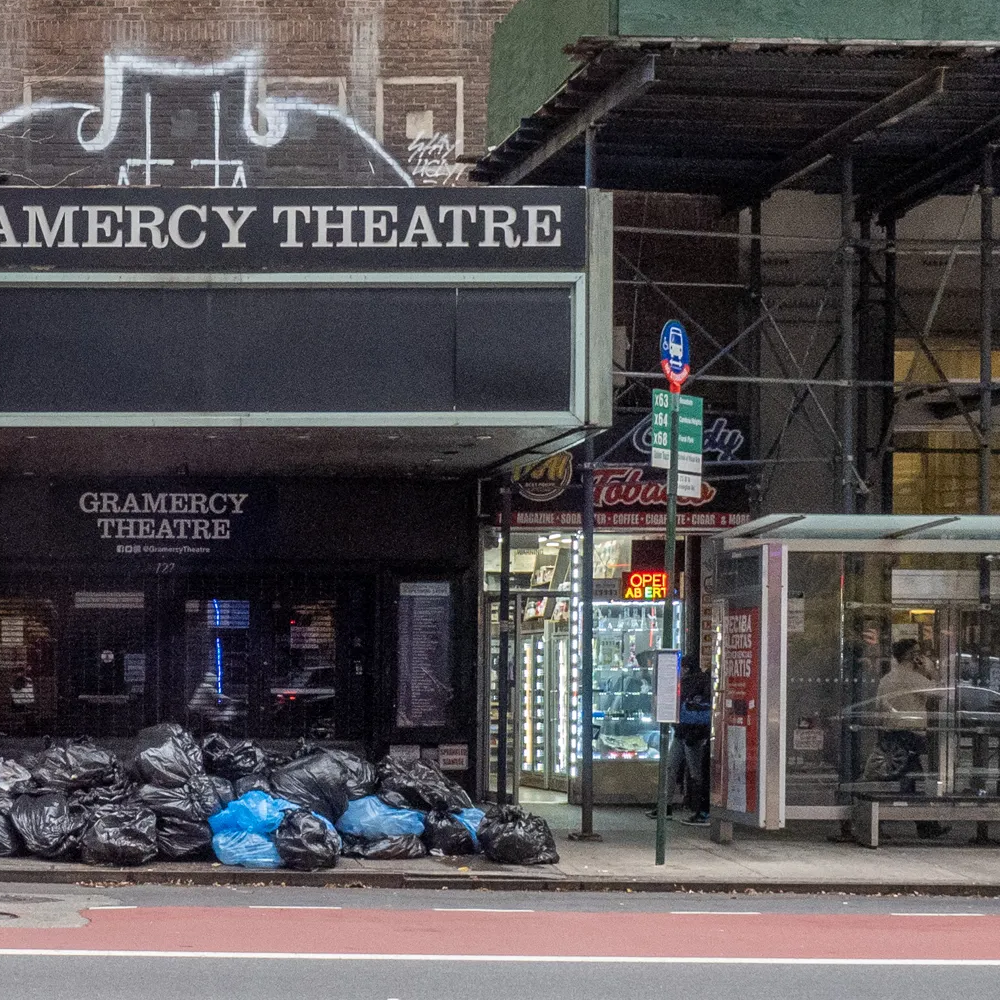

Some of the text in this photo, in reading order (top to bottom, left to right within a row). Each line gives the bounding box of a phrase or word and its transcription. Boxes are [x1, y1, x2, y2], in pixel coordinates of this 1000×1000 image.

[272, 205, 562, 248] THEATRE
[79, 492, 249, 514] GRAMERCY
[97, 518, 231, 540] THEATRE
[516, 512, 555, 524] MAGAZINE
[561, 512, 582, 525] SODA
[613, 513, 640, 525] COFFEE
[691, 514, 715, 525] CIGAR
